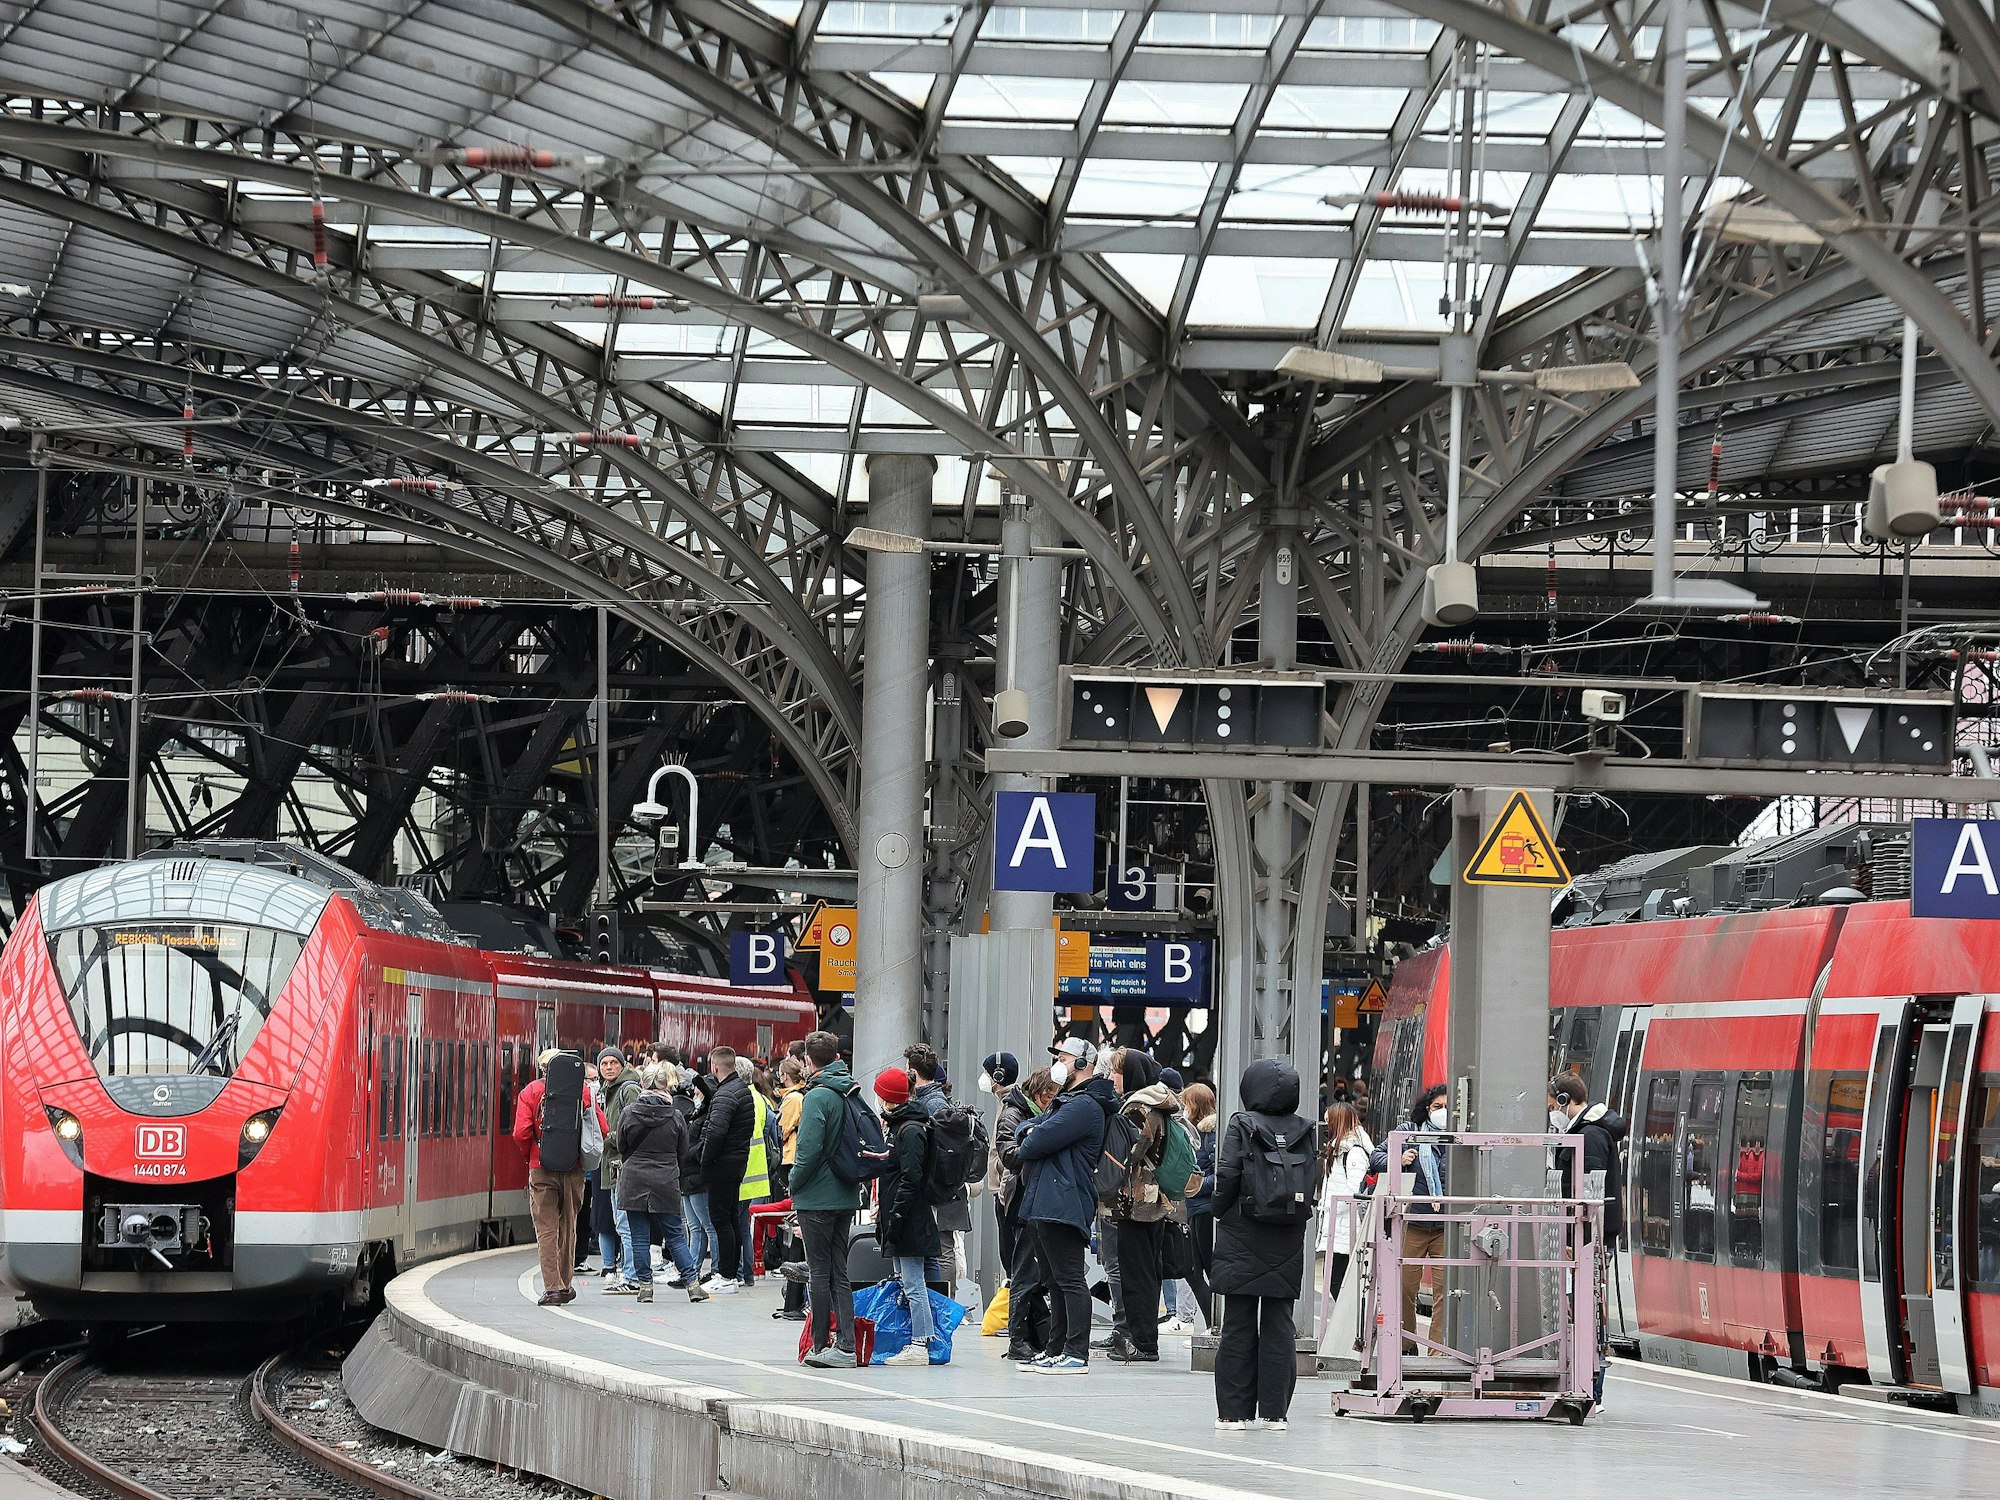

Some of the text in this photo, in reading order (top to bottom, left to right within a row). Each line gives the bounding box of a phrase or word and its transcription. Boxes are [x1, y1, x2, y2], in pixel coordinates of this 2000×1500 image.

[1009, 797, 1068, 868] A
[1940, 823, 1999, 895] A
[1123, 867, 1147, 901] 3
[749, 934, 777, 974] B
[827, 958, 857, 967] Rauch
[1105, 960, 1126, 969] nicht
[1164, 943, 1193, 984] B
[142, 1130, 180, 1153] DB
[133, 1163, 186, 1176] 1440 874
